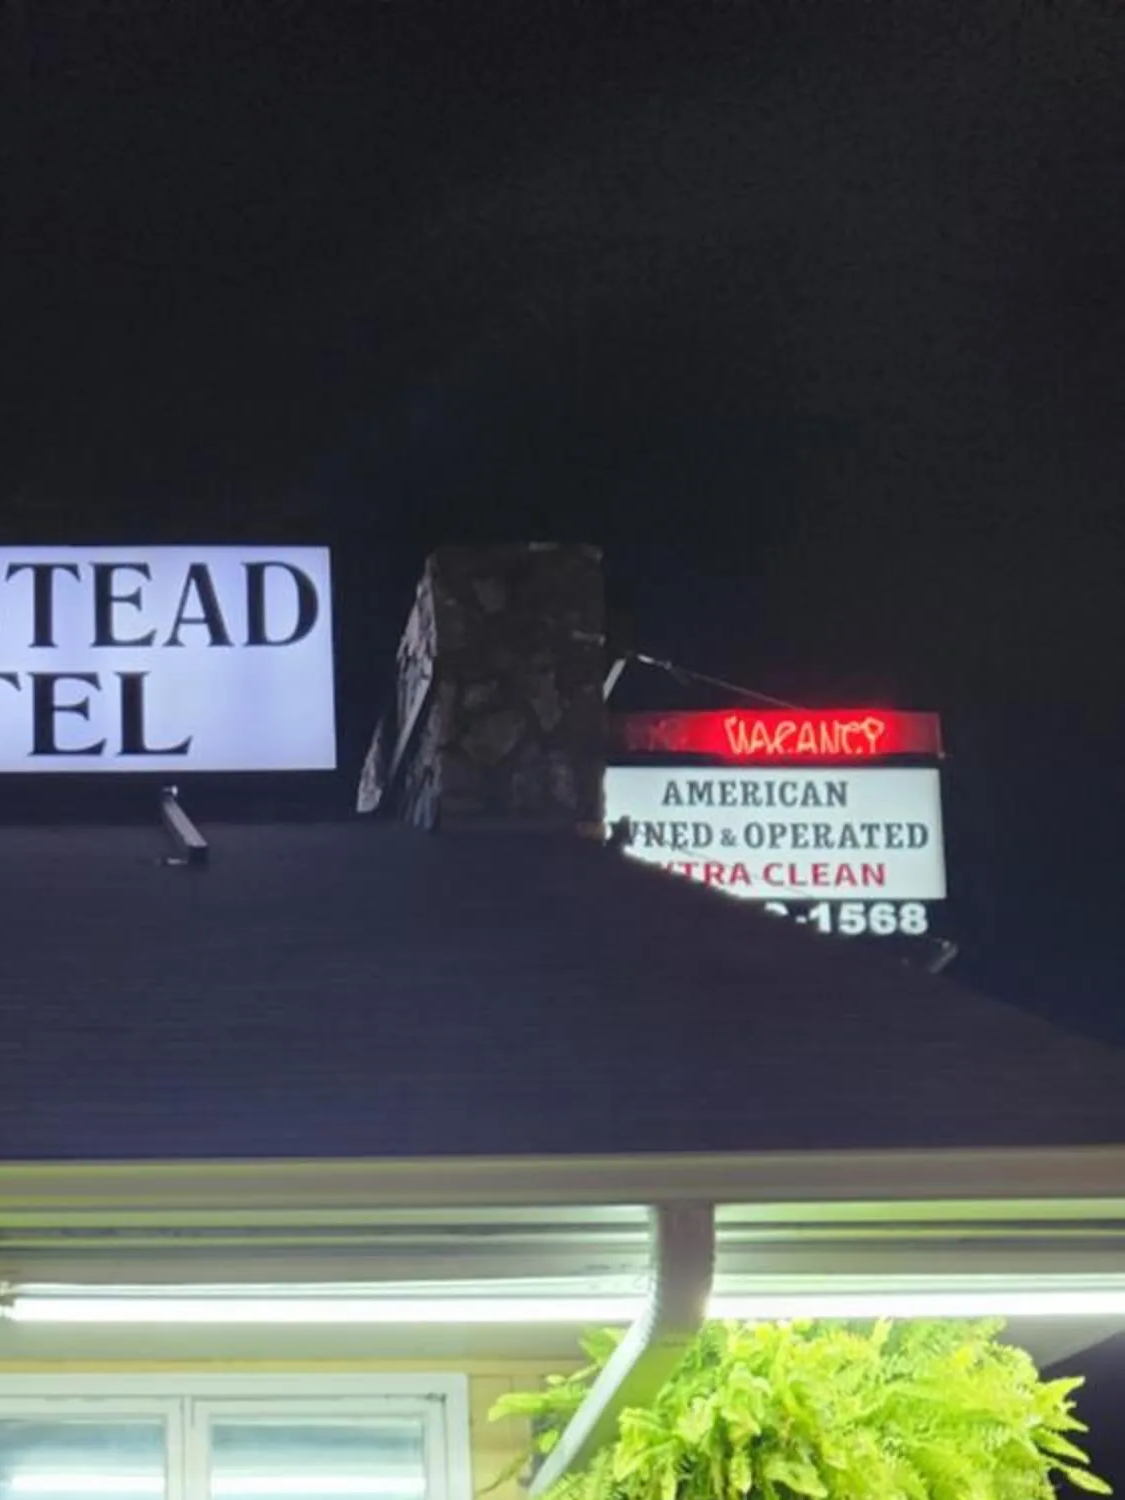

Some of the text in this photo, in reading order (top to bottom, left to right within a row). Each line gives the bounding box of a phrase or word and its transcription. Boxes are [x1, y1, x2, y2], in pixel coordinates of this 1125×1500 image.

[661, 780, 849, 807] AMERICAN
[743, 821, 929, 850] OPERATED
[762, 863, 886, 887] CLEAN
